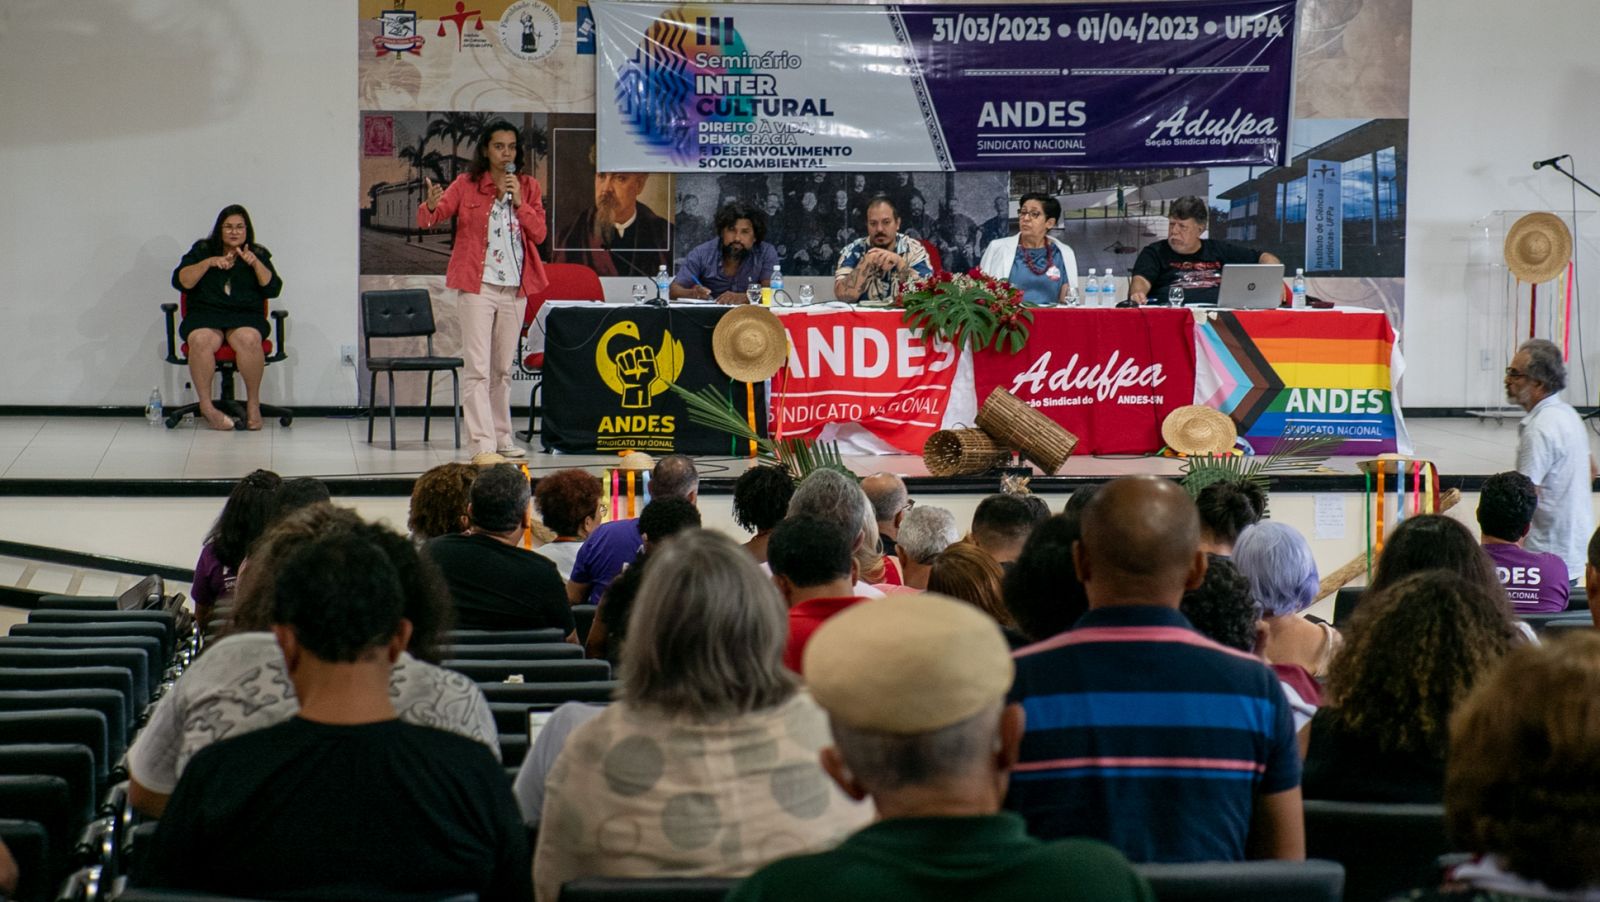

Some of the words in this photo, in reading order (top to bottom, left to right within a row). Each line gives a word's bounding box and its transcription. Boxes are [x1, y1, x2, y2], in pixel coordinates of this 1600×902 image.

[696, 16, 734, 46] III
[932, 14, 1051, 43] 31/03/2023
[1077, 13, 1199, 43] 01/04/2023
[1225, 15, 1284, 39] UFPA
[695, 50, 802, 69] Seminário
[694, 73, 778, 96] INTER
[696, 98, 834, 117] CULTURAL
[977, 101, 1087, 128] ANDES
[698, 121, 757, 133] DIREITO
[758, 118, 772, 134] À
[1150, 106, 1279, 146] Adufpa
[698, 133, 798, 146] DEMOCRACIA
[977, 140, 1032, 151] SINDICATO
[1033, 138, 1086, 150] NACIONAL
[1145, 138, 1172, 147] Seção
[1173, 137, 1208, 146] Sindical
[1209, 137, 1221, 146] do
[711, 146, 853, 156] DESENVOLVIMENTO
[698, 158, 828, 168] SOCIOAMBIENTAL
[1315, 222, 1324, 234] de
[1315, 235, 1324, 269] Instituto
[1009, 350, 1167, 402] Adufpa
[1042, 396, 1081, 407] Sindical
[1082, 396, 1094, 405] do
[1117, 395, 1164, 405] ANDES-SN
[1285, 388, 1384, 414] ANDES
[597, 415, 676, 433] ANDES
[1337, 426, 1382, 436] NACIONAL
[1495, 566, 1542, 585] DES
[1507, 591, 1540, 600] ACIONAL
